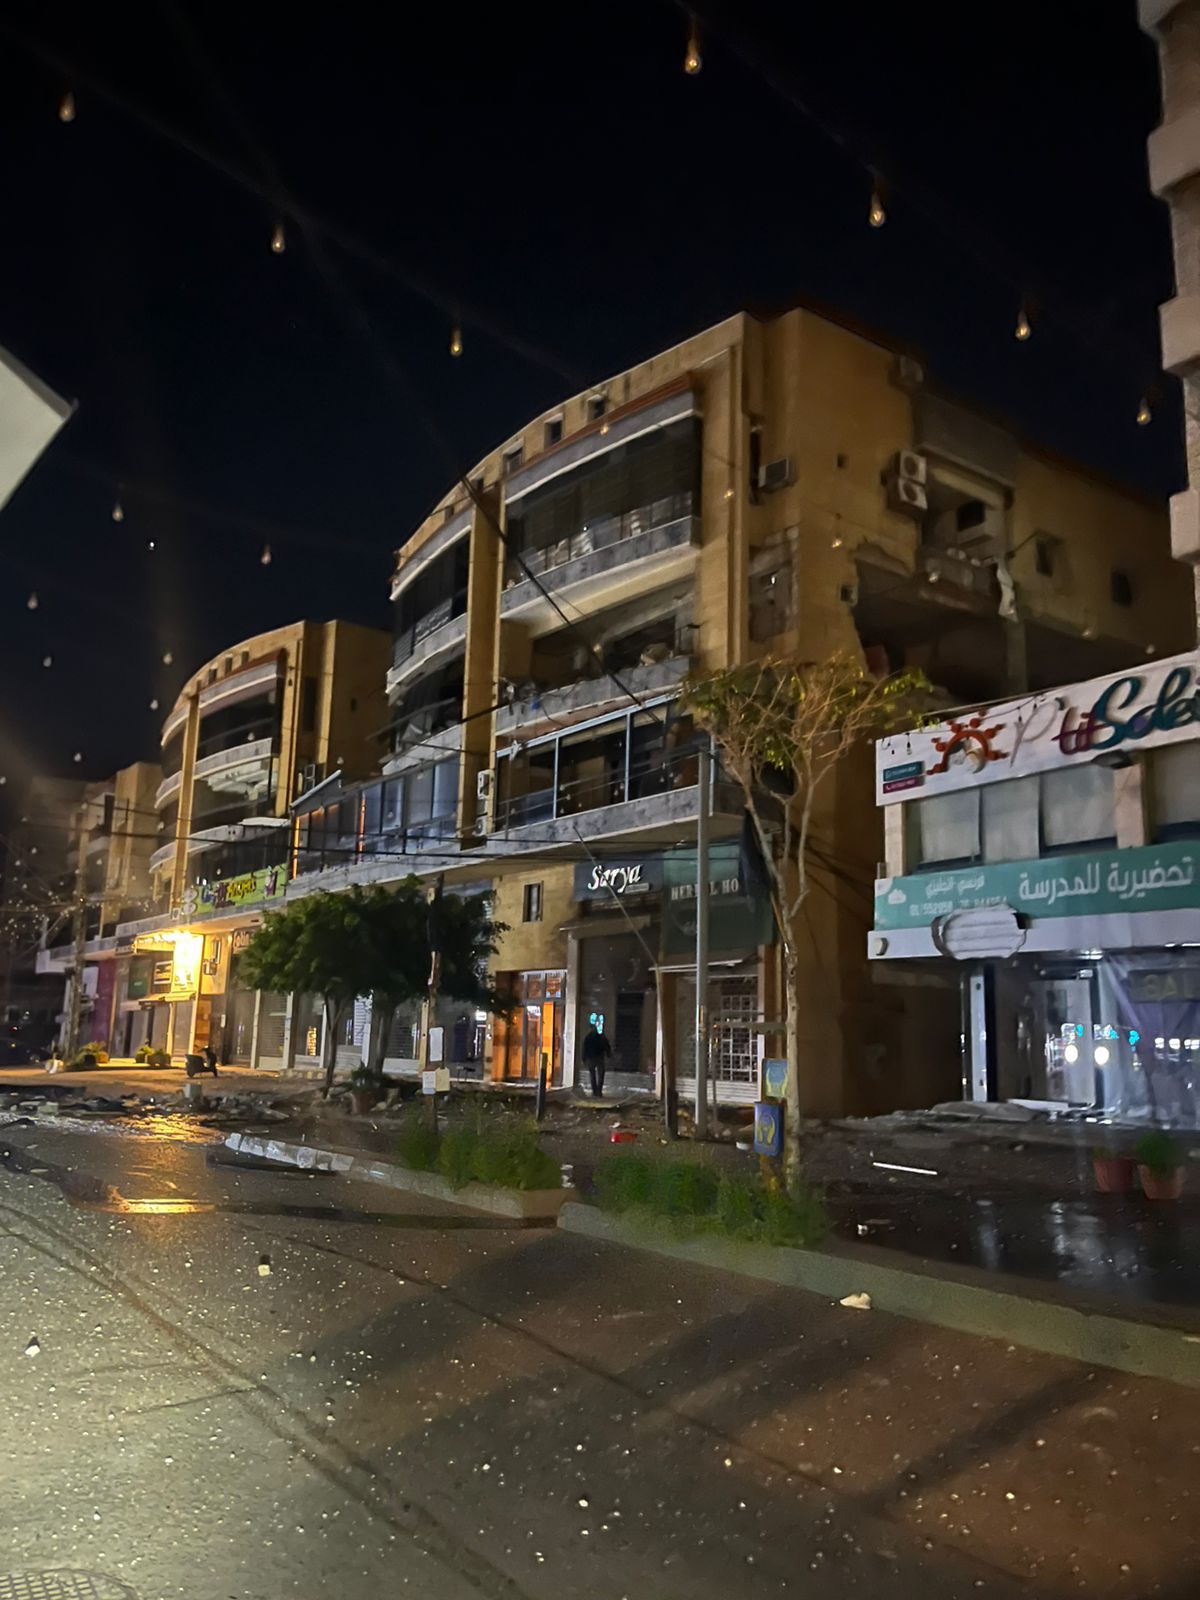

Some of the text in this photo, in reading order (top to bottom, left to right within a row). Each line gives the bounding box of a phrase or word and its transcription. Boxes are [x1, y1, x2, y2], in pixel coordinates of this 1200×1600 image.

[588, 864, 641, 893] Sarya
[671, 880, 717, 900] HERL
[1018, 857, 1195, 905] تحضيرية للمدرسة
